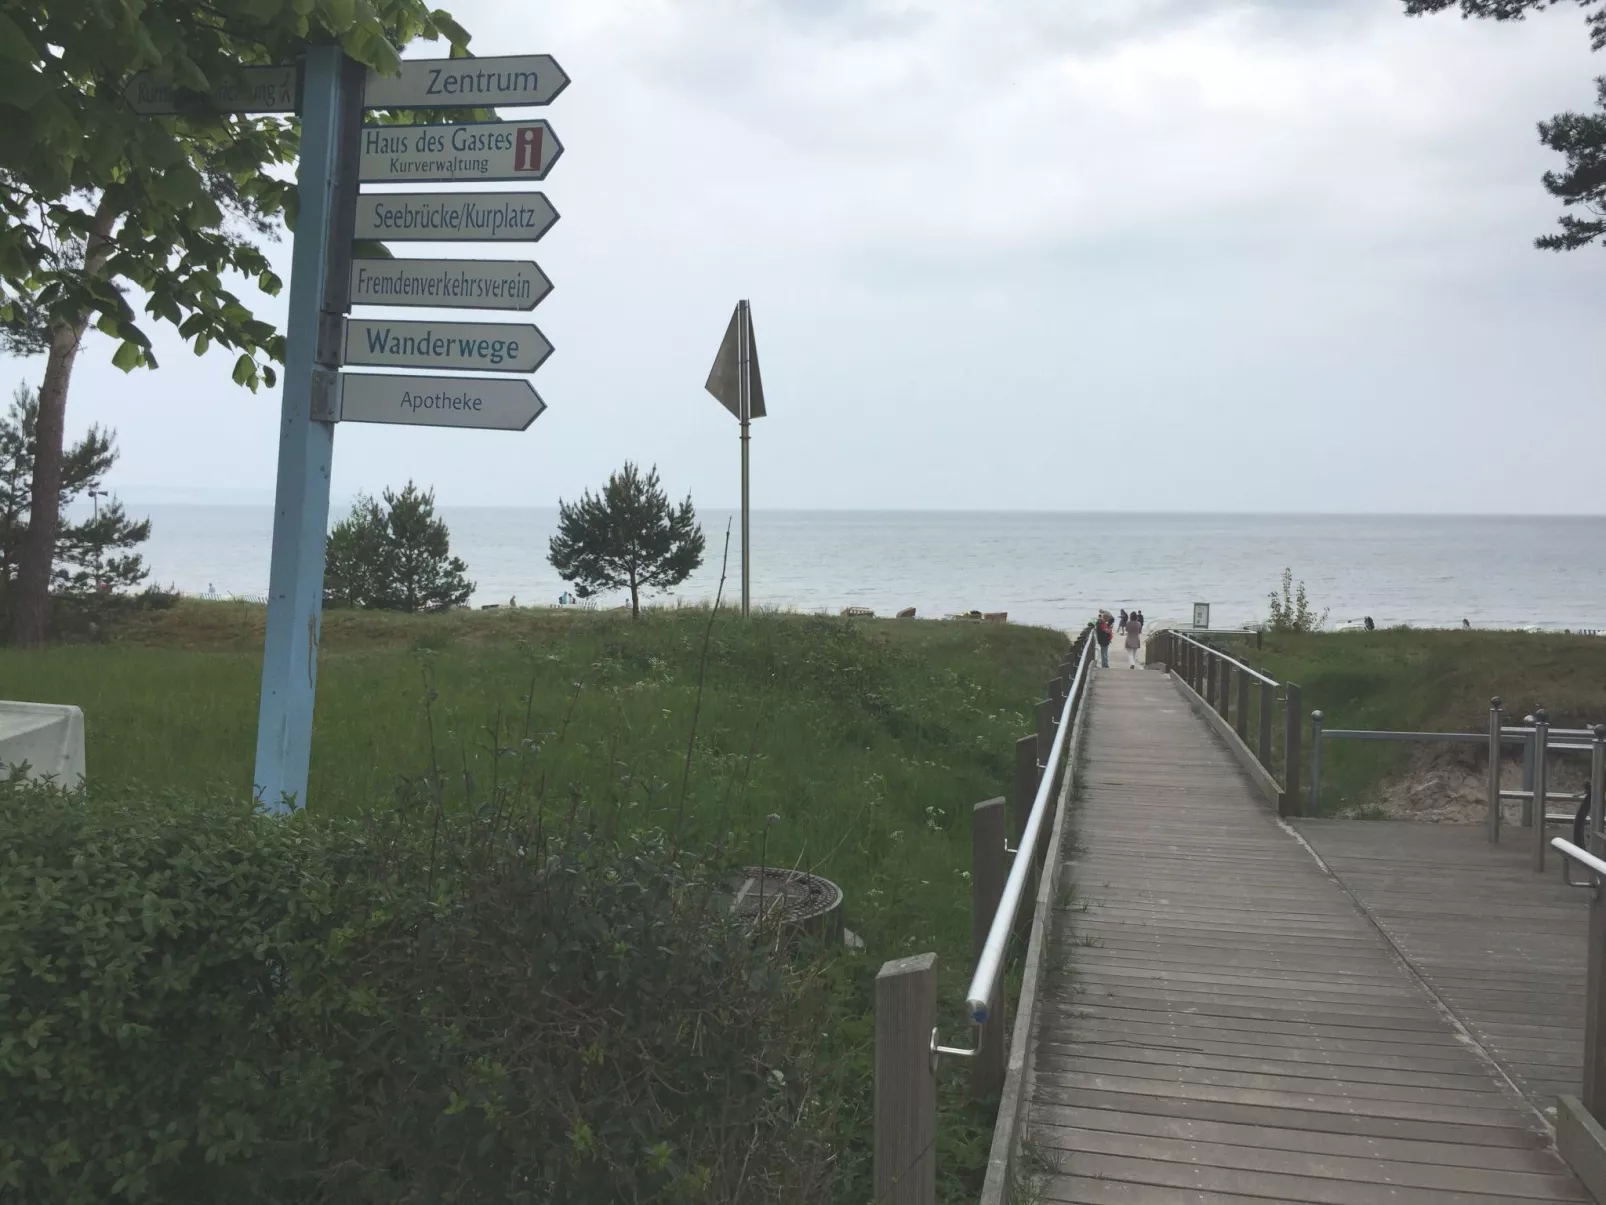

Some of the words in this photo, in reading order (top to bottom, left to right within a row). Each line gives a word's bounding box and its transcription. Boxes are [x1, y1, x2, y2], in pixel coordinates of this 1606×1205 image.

[425, 68, 539, 95] Zentrum
[365, 130, 408, 155] Haus
[415, 129, 445, 153] des
[451, 127, 513, 152] Gastes
[389, 156, 489, 174] Kurverwaltung
[373, 202, 535, 235] Seebrücke/Kurplatz
[357, 268, 531, 298] Fremdenverkehrsverein
[366, 327, 519, 364] Wanderwege
[400, 390, 483, 413] Apotheke
